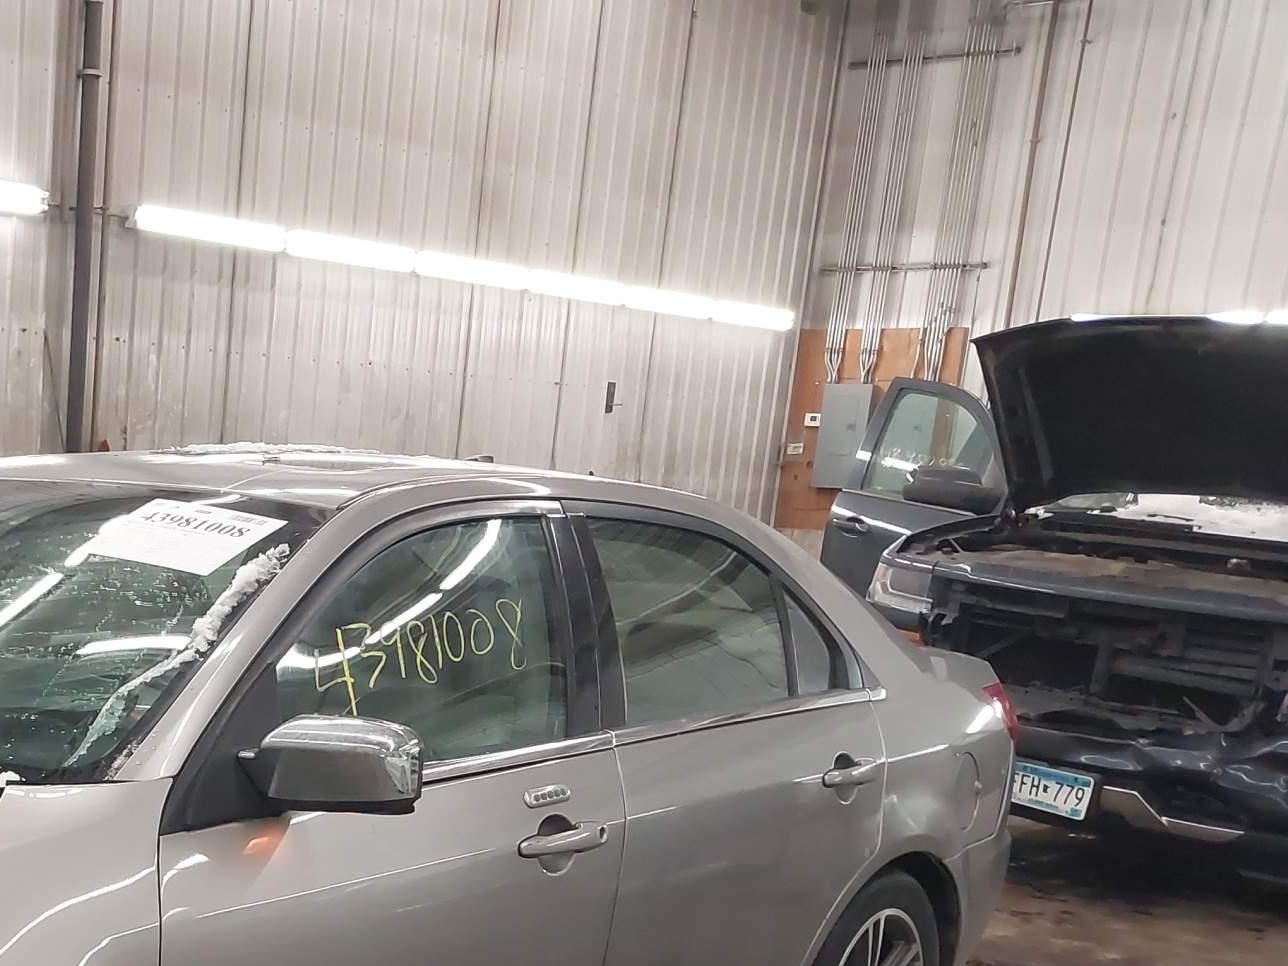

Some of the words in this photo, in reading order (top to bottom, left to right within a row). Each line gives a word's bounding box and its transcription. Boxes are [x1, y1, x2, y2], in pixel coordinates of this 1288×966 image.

[140, 511, 251, 538] 43981008
[314, 598, 527, 717] 43981008
[1053, 781, 1085, 807] 779
